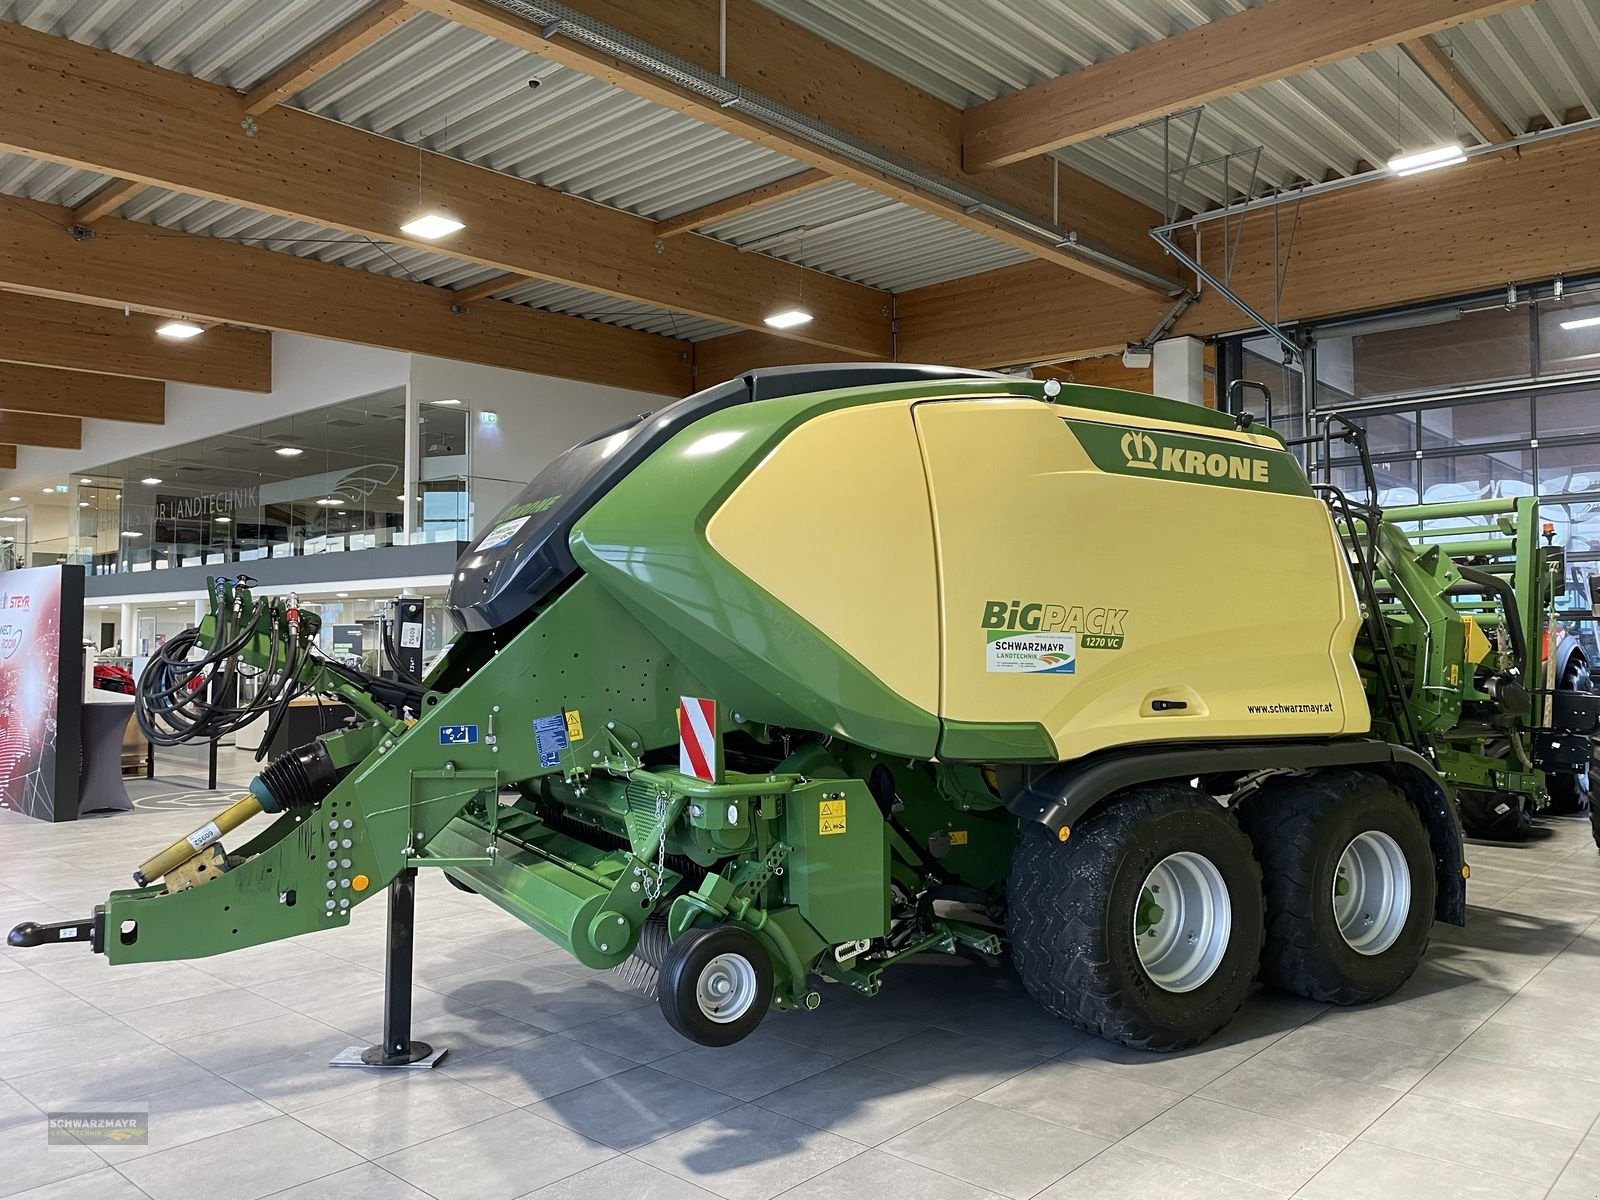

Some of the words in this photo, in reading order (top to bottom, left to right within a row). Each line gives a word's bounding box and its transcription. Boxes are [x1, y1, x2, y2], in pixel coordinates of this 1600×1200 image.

[1161, 447, 1269, 483] KRONE
[170, 487, 257, 520] LANDTECHNIK
[10, 596, 30, 608] STEYR
[995, 641, 1064, 652] SCHWARZMAYR
[1086, 637, 1105, 648] 1270
[1107, 638, 1119, 648] VC
[996, 652, 1038, 660] LANDTECHNIK
[1247, 702, 1333, 714] www.schwarzmayr.at
